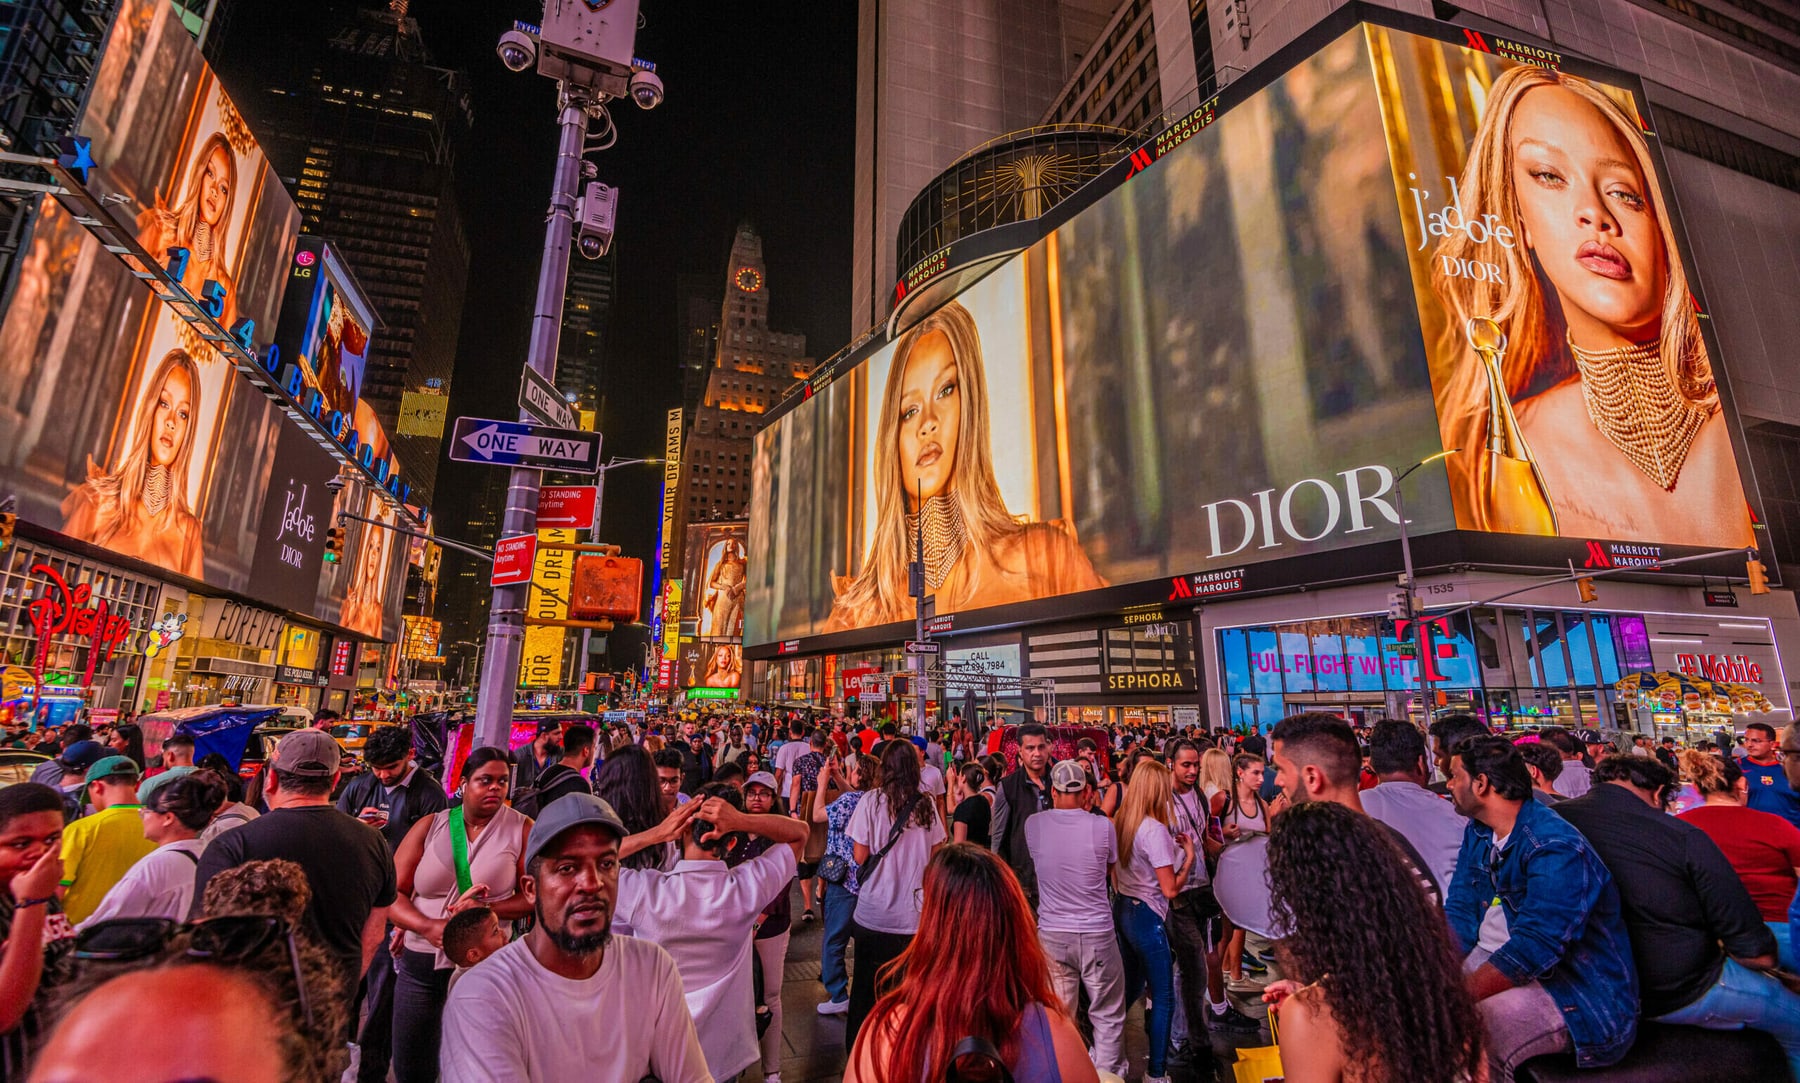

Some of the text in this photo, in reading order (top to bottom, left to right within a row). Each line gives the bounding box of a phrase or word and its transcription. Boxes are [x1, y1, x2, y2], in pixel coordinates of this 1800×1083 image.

[1496, 38, 1561, 63] MARRIOTT
[1157, 96, 1219, 146] MARRIOTT
[1158, 113, 1213, 157] MARQUIS
[1408, 172, 1516, 252] j'adore
[294, 267, 311, 278] LG
[908, 247, 951, 280] MARRIOTT
[909, 260, 945, 291] MARQUIS
[1440, 255, 1505, 285] DIOR
[531, 385, 573, 430] ONE WAY
[477, 432, 581, 458] ONE WAY
[667, 426, 680, 481] DREAMS
[539, 501, 564, 509] nytime
[548, 490, 581, 499] STANDING
[1201, 465, 1412, 558] DIOR
[280, 544, 303, 569] DIOR
[496, 554, 515, 564] Anytime
[497, 541, 527, 553] NO STANDING
[1611, 544, 1661, 557] MARRIOTT
[1194, 569, 1245, 584] MARRIOTT
[1195, 580, 1240, 594] MARQUIS
[1427, 583, 1454, 595] 1535
[537, 588, 559, 630] OUR
[1123, 611, 1163, 624] SEPHORA
[214, 600, 288, 651] FOREVER
[970, 651, 990, 661] CALL
[1294, 653, 1355, 675] FLIGHT
[1109, 673, 1183, 689] SEPHORA
